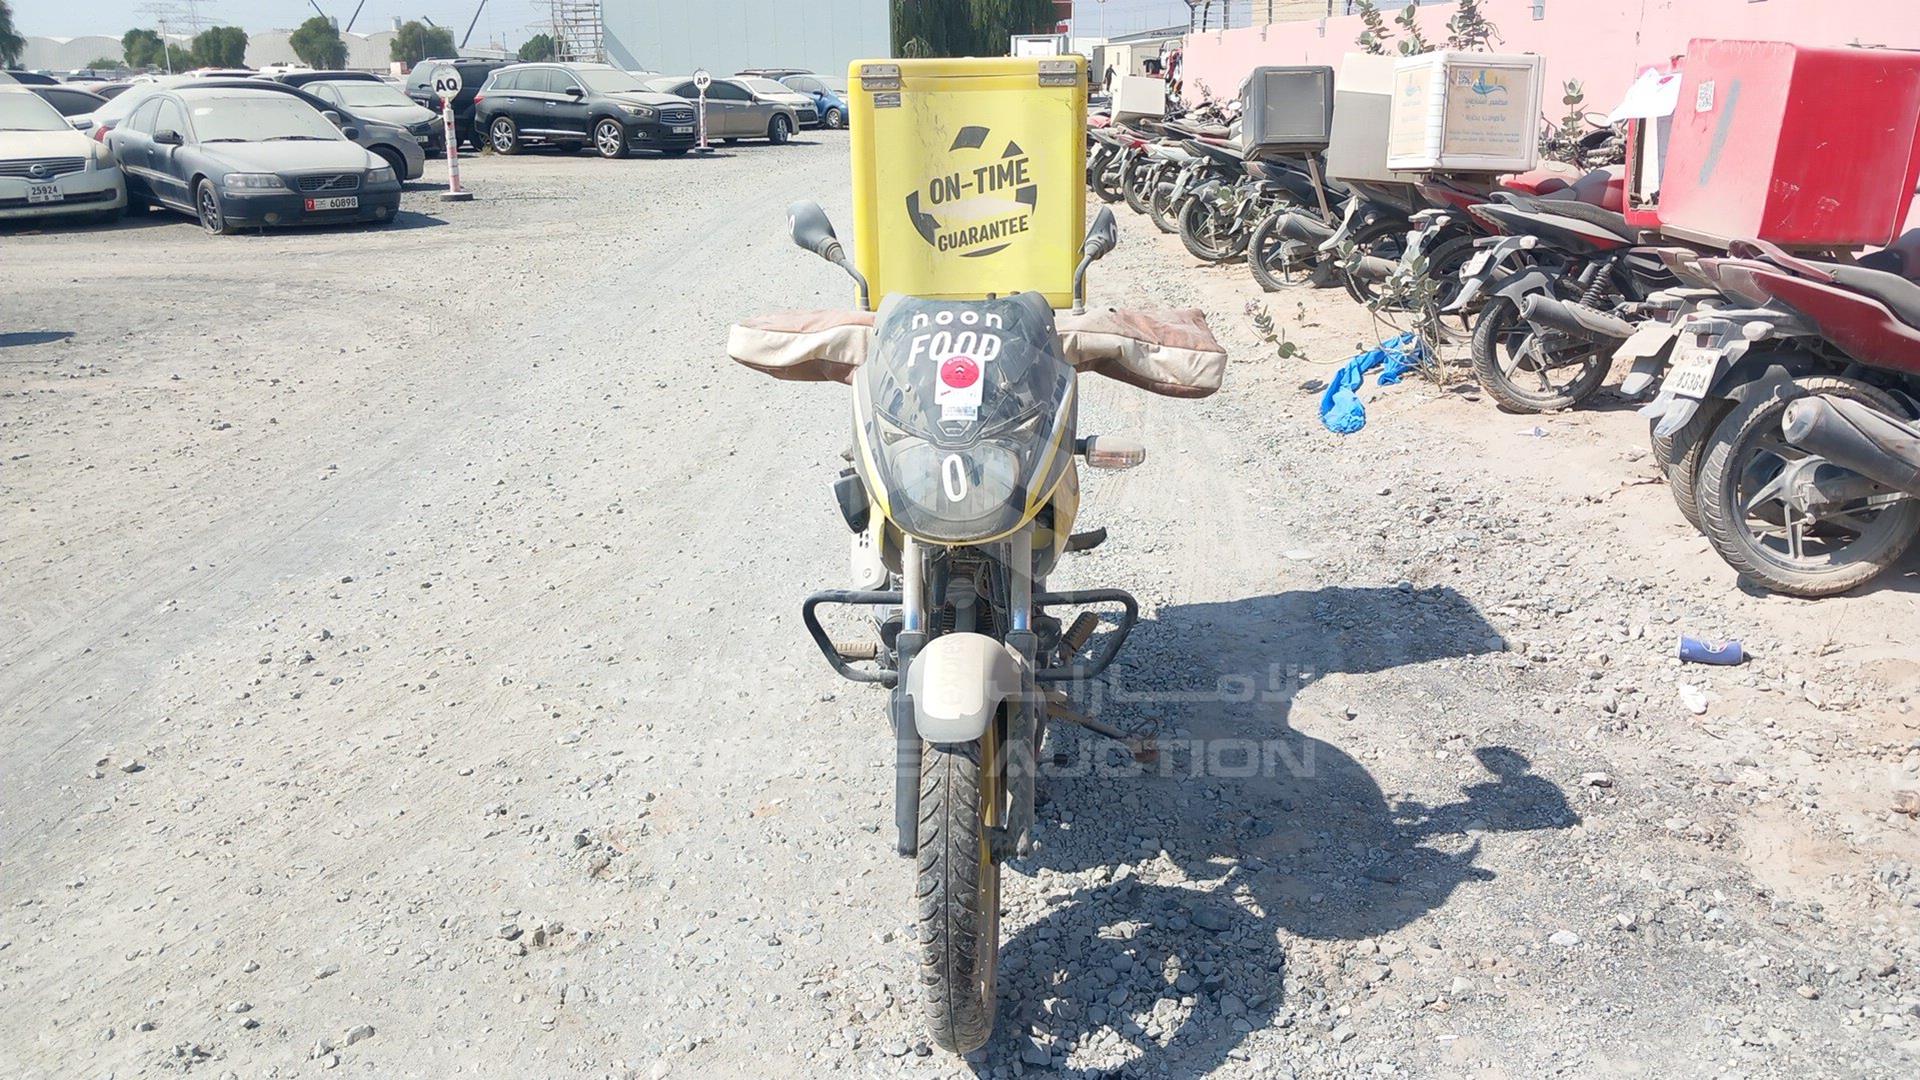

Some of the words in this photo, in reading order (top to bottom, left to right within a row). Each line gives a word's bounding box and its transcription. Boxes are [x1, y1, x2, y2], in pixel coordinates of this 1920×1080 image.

[435, 78, 459, 92] AQ
[696, 76, 709, 86] AP
[929, 157, 1030, 205] ON-TIME
[31, 185, 58, 196] 25924
[330, 198, 357, 208] 60898
[938, 214, 1029, 252] GUARANTEE
[911, 310, 1003, 331] noon
[907, 330, 1002, 367] FOOD
